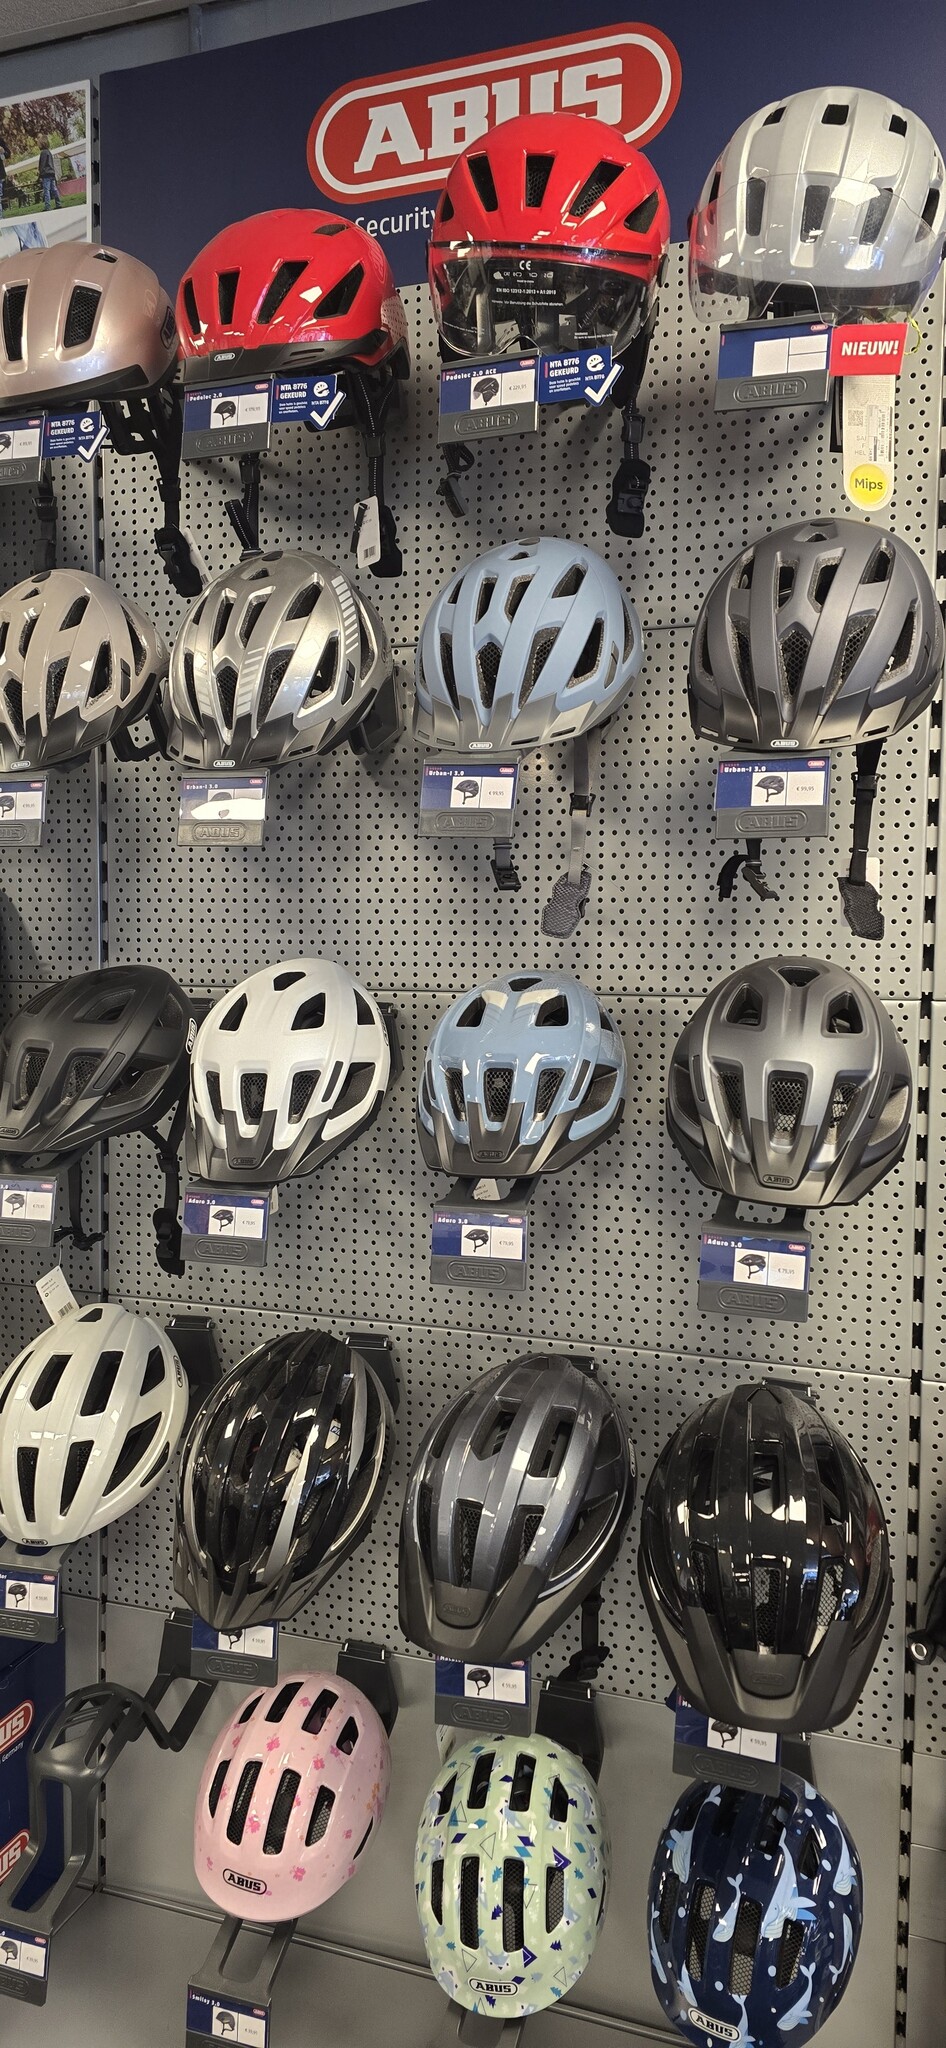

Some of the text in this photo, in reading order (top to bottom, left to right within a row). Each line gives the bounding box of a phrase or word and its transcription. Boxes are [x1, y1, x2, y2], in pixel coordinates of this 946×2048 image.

[354, 57, 622, 173] ABUS
[842, 340, 898, 356] NIEUW!
[564, 358, 580, 366] 8776
[446, 373, 470, 381] Pedelec
[550, 367, 579, 377] GEKEURD
[745, 381, 798, 399] ABUS
[466, 414, 512, 432] ABUS
[855, 478, 883, 491] Mips
[744, 815, 798, 828] ABUS
[199, 827, 240, 838] ABUS
[767, 1176, 790, 1184] ABUS
[455, 1266, 500, 1280] ABUS
[727, 1292, 778, 1310] ABUS
[2, 1741, 24, 1762] Germany
[228, 1873, 261, 1891] ABUS
[476, 1982, 511, 1992] ABUS
[696, 2015, 733, 2037] ABUS
